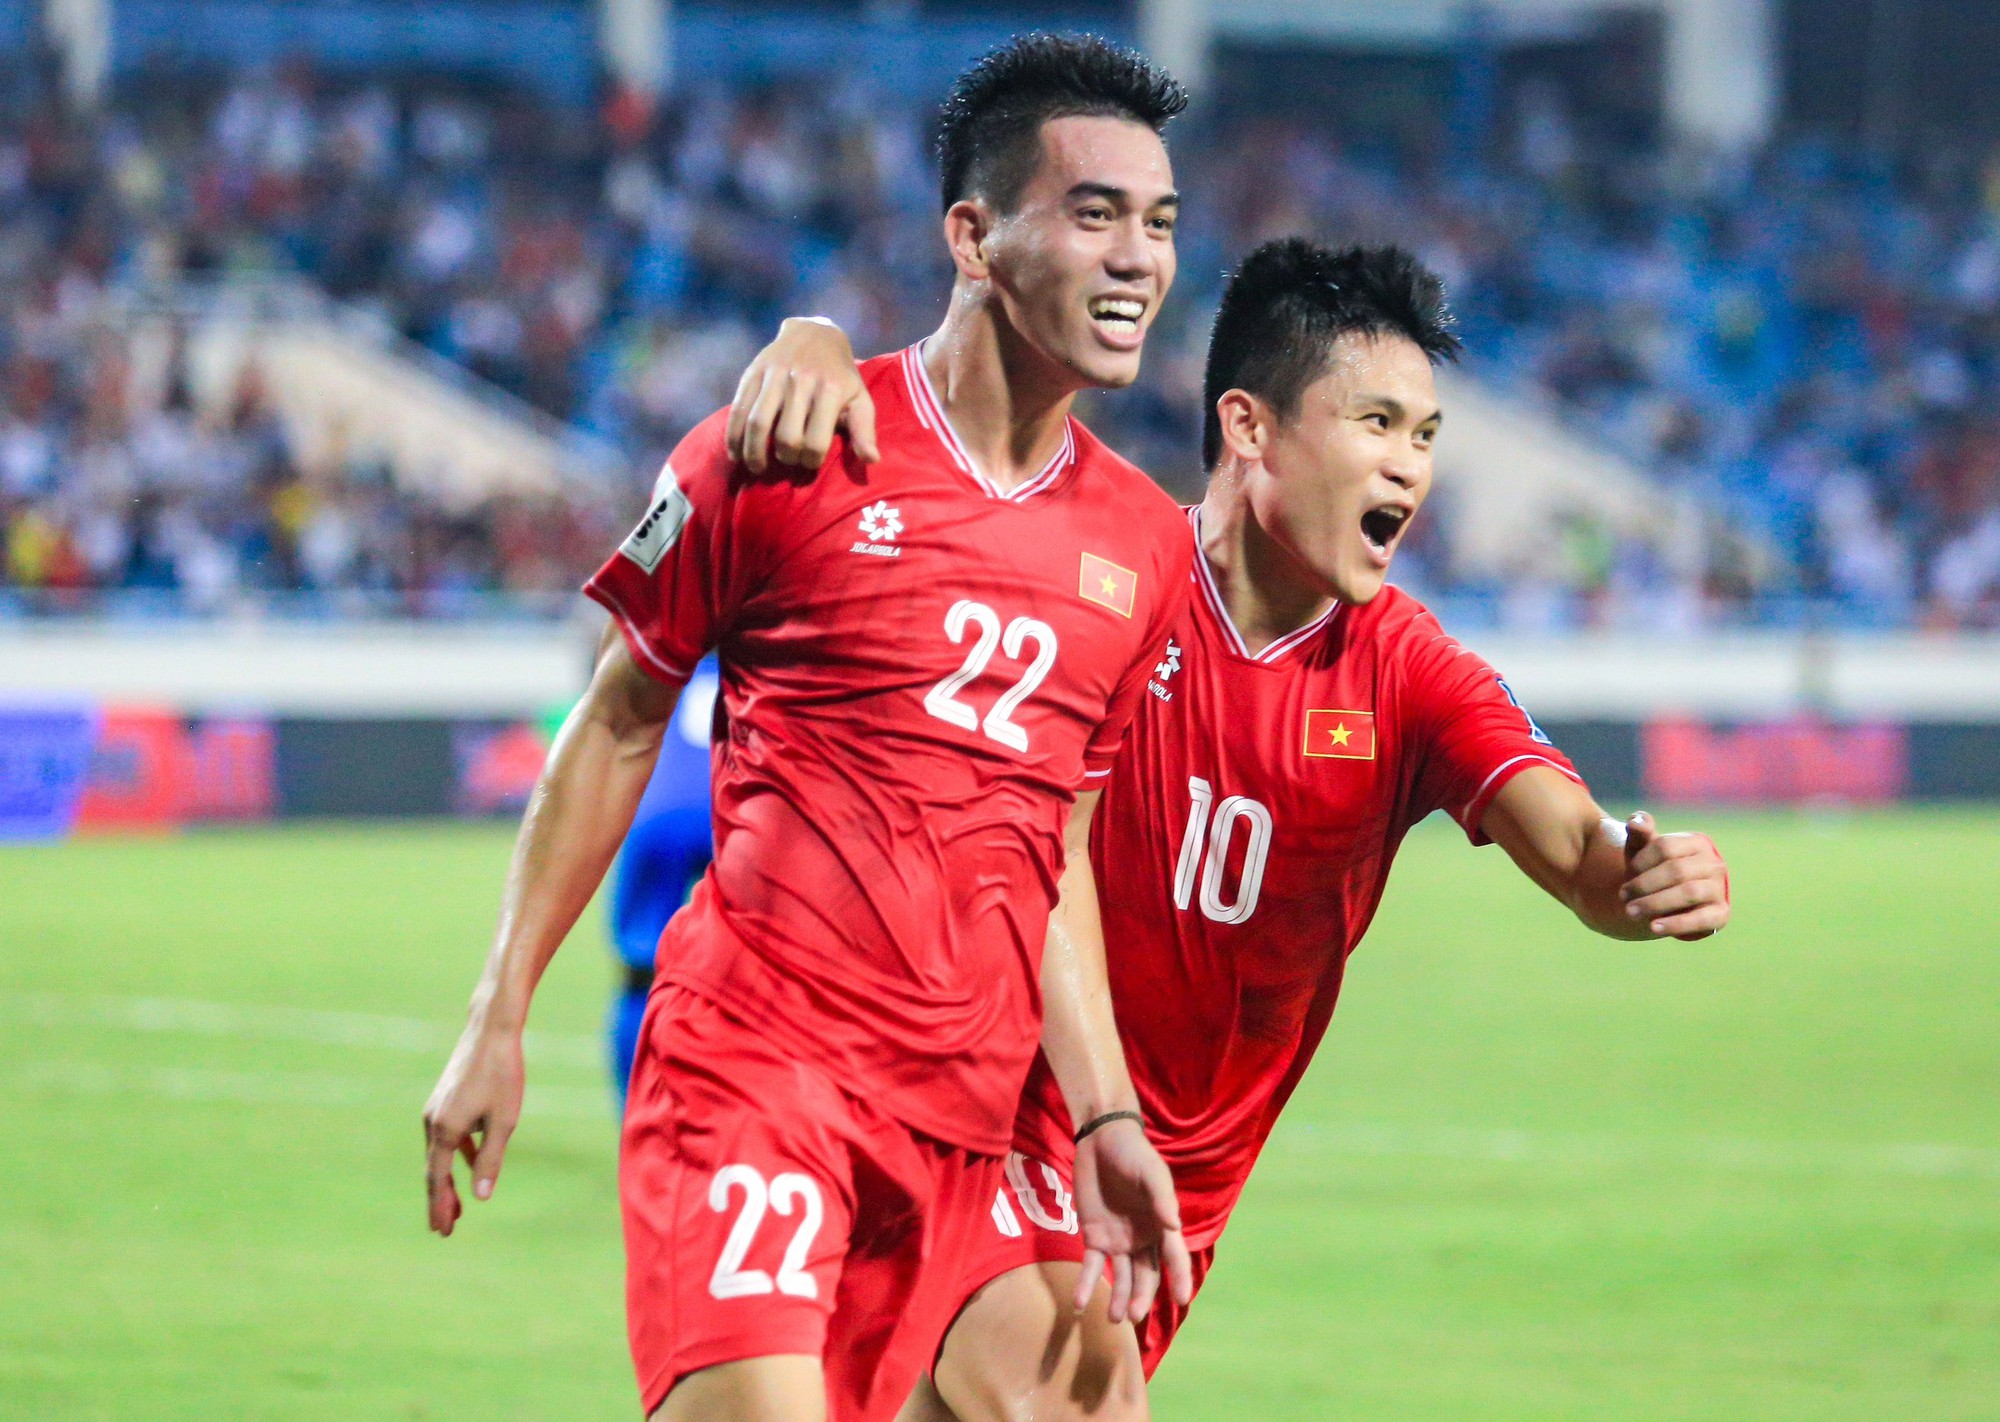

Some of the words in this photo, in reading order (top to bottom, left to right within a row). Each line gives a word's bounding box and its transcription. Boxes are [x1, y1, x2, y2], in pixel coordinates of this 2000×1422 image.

[923, 599, 1058, 753] 22
[1173, 775, 1273, 924] 10
[708, 1163, 823, 1300] 22
